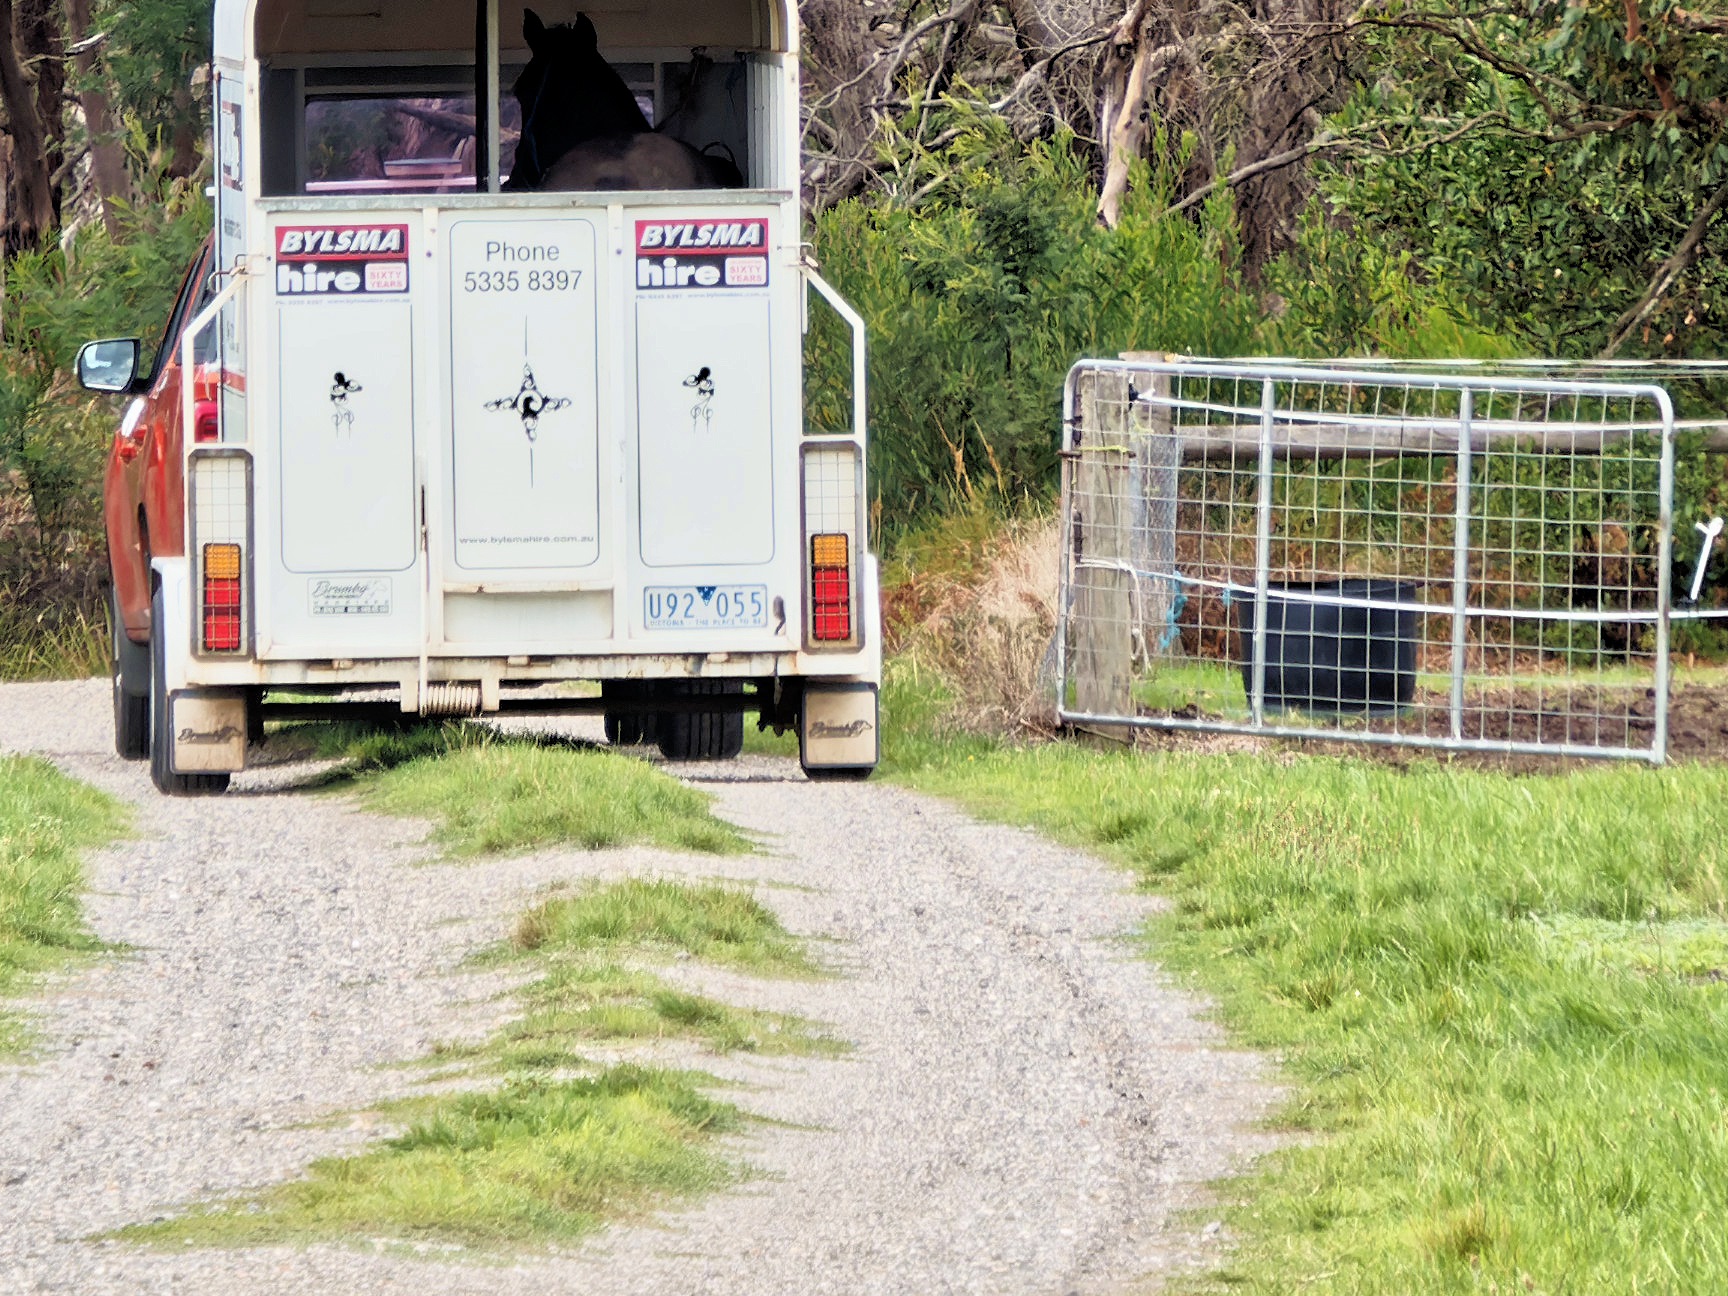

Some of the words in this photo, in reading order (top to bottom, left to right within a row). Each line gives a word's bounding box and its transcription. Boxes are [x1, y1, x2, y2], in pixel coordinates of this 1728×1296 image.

[280, 229, 404, 254] BYLSMA
[640, 223, 764, 248] BYLSMA
[486, 241, 560, 261] Phone
[277, 263, 360, 293] hire
[370, 271, 401, 279] SIXTY
[464, 270, 519, 293] 5335
[528, 270, 582, 291] 8397
[637, 257, 720, 286] hire
[730, 266, 761, 274] SIXTY
[731, 274, 762, 282] YEARS
[371, 280, 403, 288] YEARS
[649, 592, 694, 619] U92
[716, 591, 761, 617] 055
